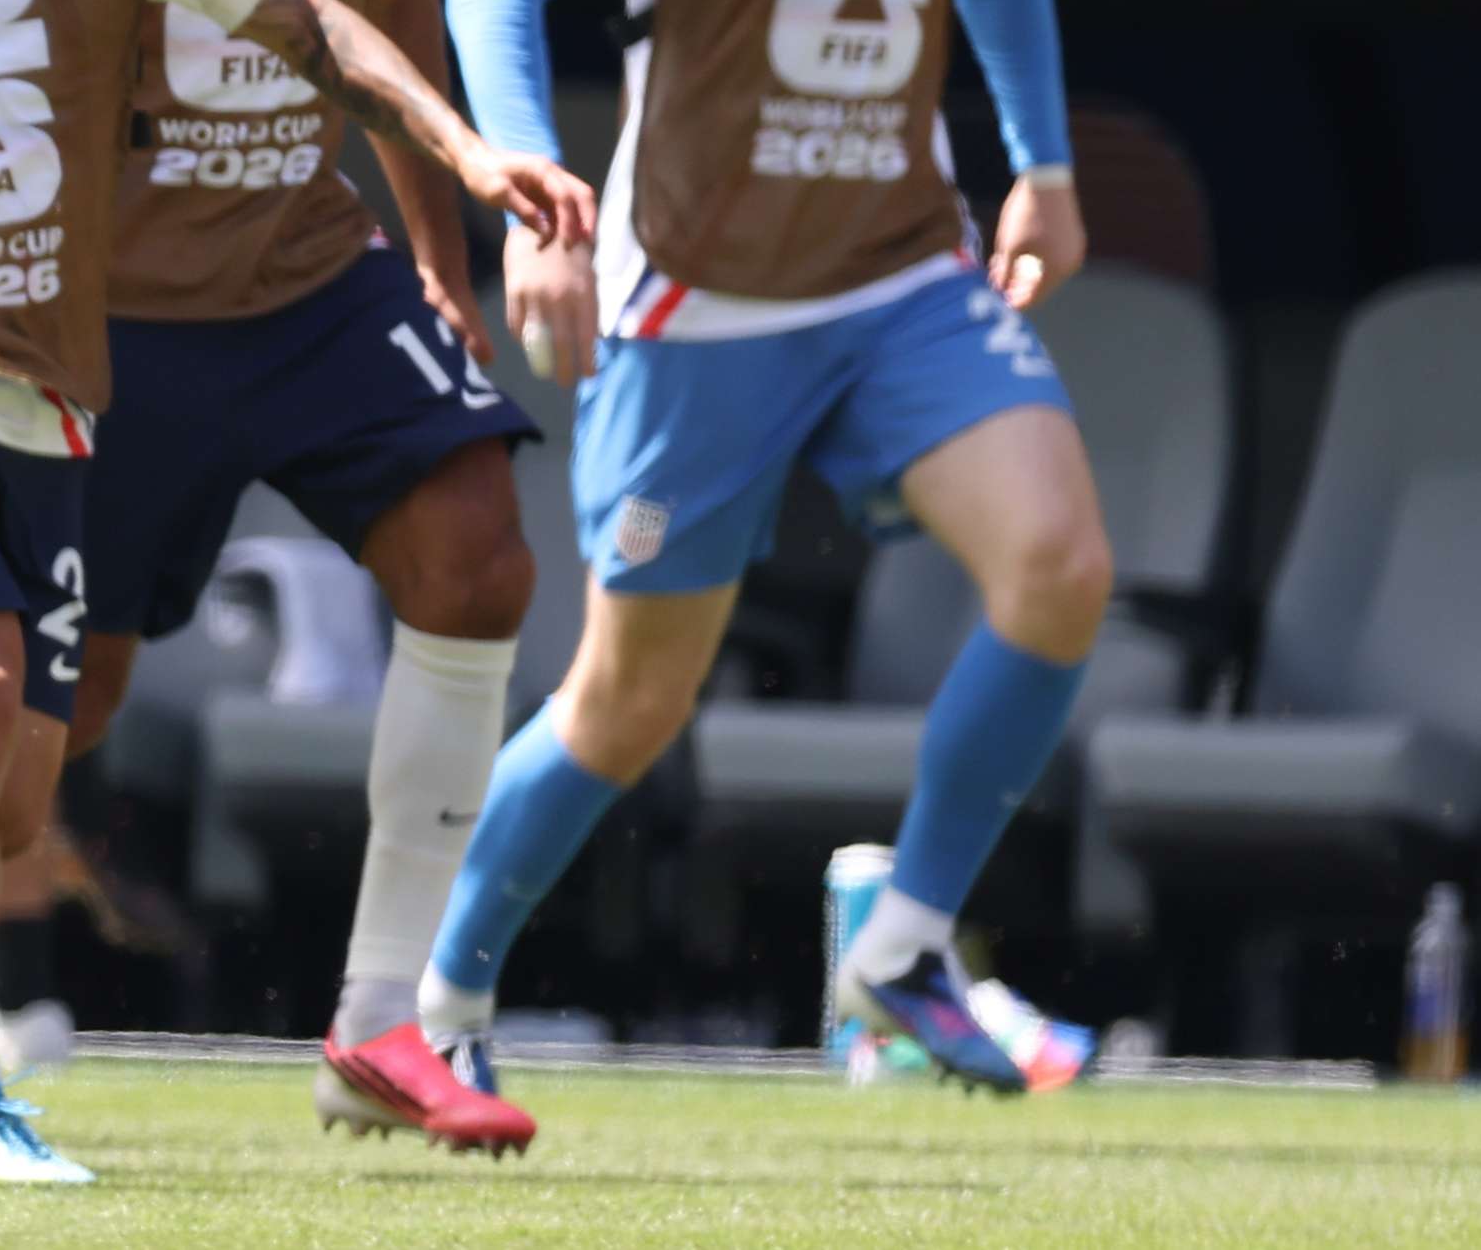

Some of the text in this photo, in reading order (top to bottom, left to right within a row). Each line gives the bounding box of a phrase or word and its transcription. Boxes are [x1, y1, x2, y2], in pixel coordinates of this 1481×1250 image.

[819, 34, 887, 67] FIFA
[221, 54, 290, 84] FIFA
[149, 143, 324, 191] 2026
[750, 126, 910, 183] 2026
[8, 225, 65, 261] CUP
